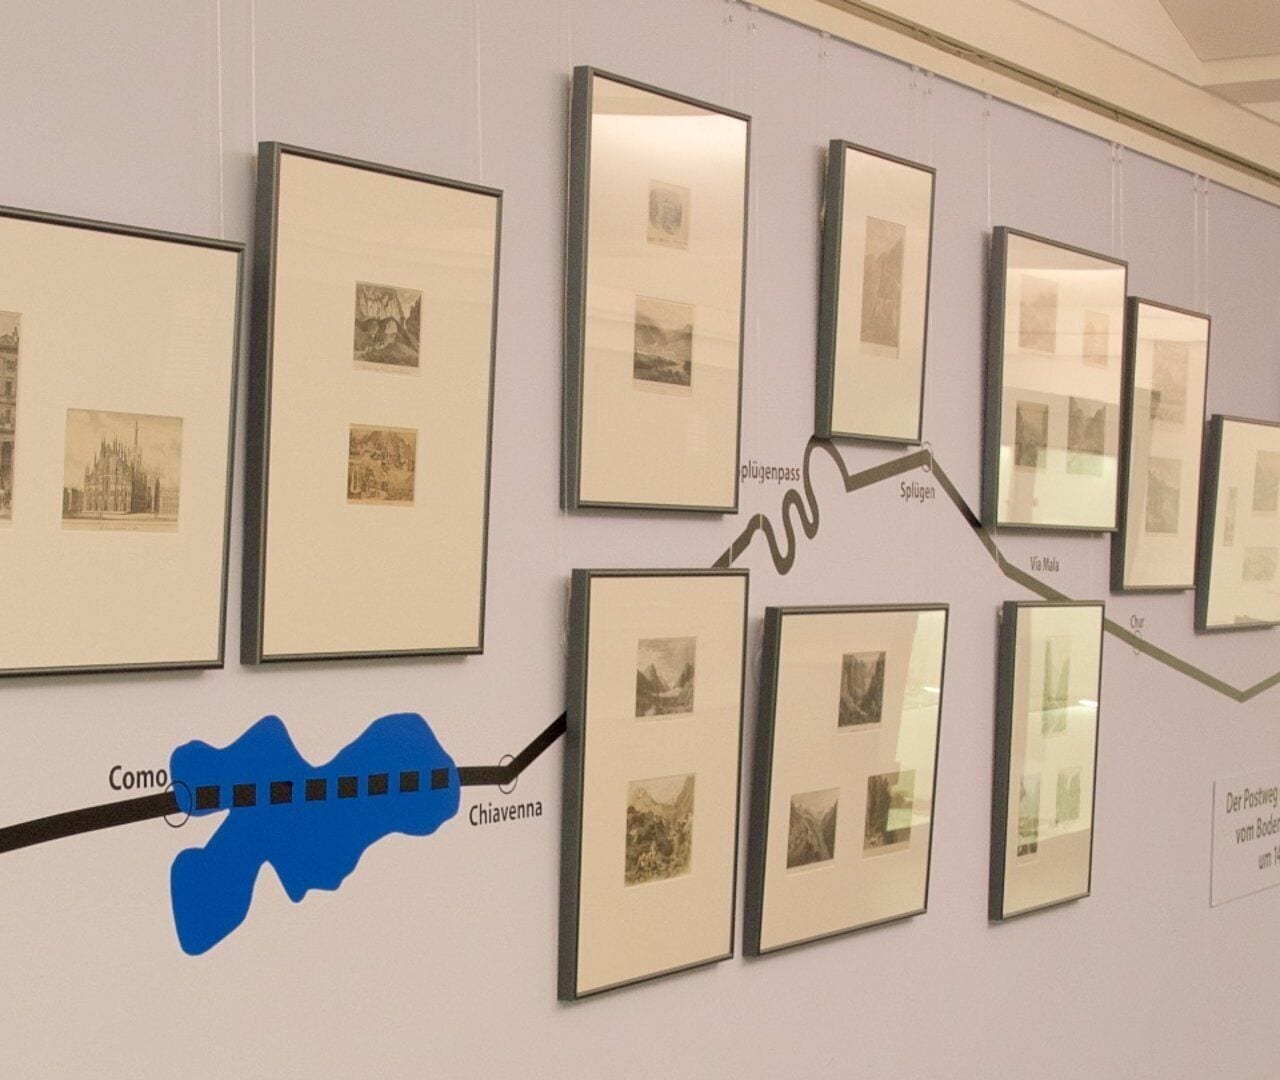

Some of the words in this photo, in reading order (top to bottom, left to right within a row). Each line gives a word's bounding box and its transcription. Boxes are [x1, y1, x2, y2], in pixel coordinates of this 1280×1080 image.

[739, 460, 801, 486] plügenpass
[900, 481, 936, 503] Splügen
[1030, 556, 1041, 571] Via
[1042, 557, 1060, 572] Mala
[108, 764, 169, 792] Como
[1226, 791, 1243, 814] Der
[1243, 786, 1279, 809] Postweg
[468, 798, 544, 829] Chiavenna
[1235, 825, 1255, 845] vom
[1258, 851, 1272, 870] um
